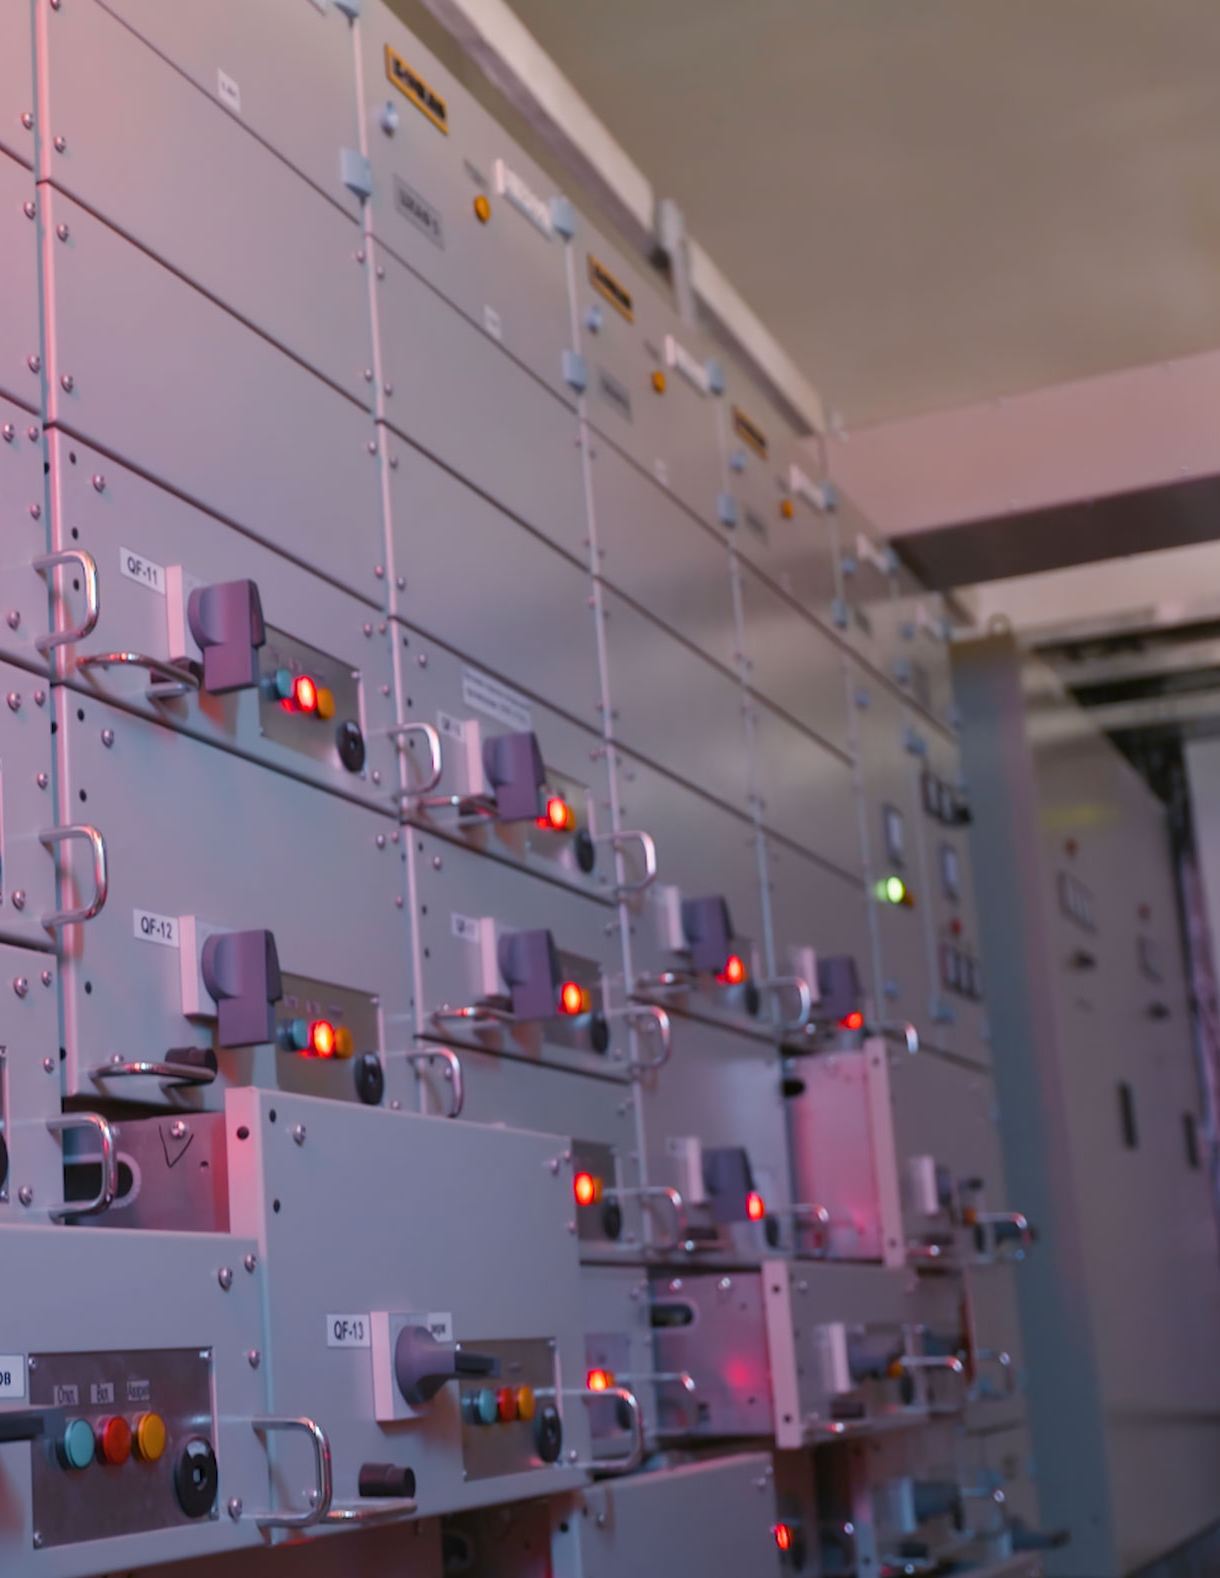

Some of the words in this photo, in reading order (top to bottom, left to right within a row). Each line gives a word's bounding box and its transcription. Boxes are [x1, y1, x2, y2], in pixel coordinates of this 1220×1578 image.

[127, 556, 157, 585] QF-11
[140, 916, 172, 940] QF-12
[333, 1320, 364, 1340] QF-13
